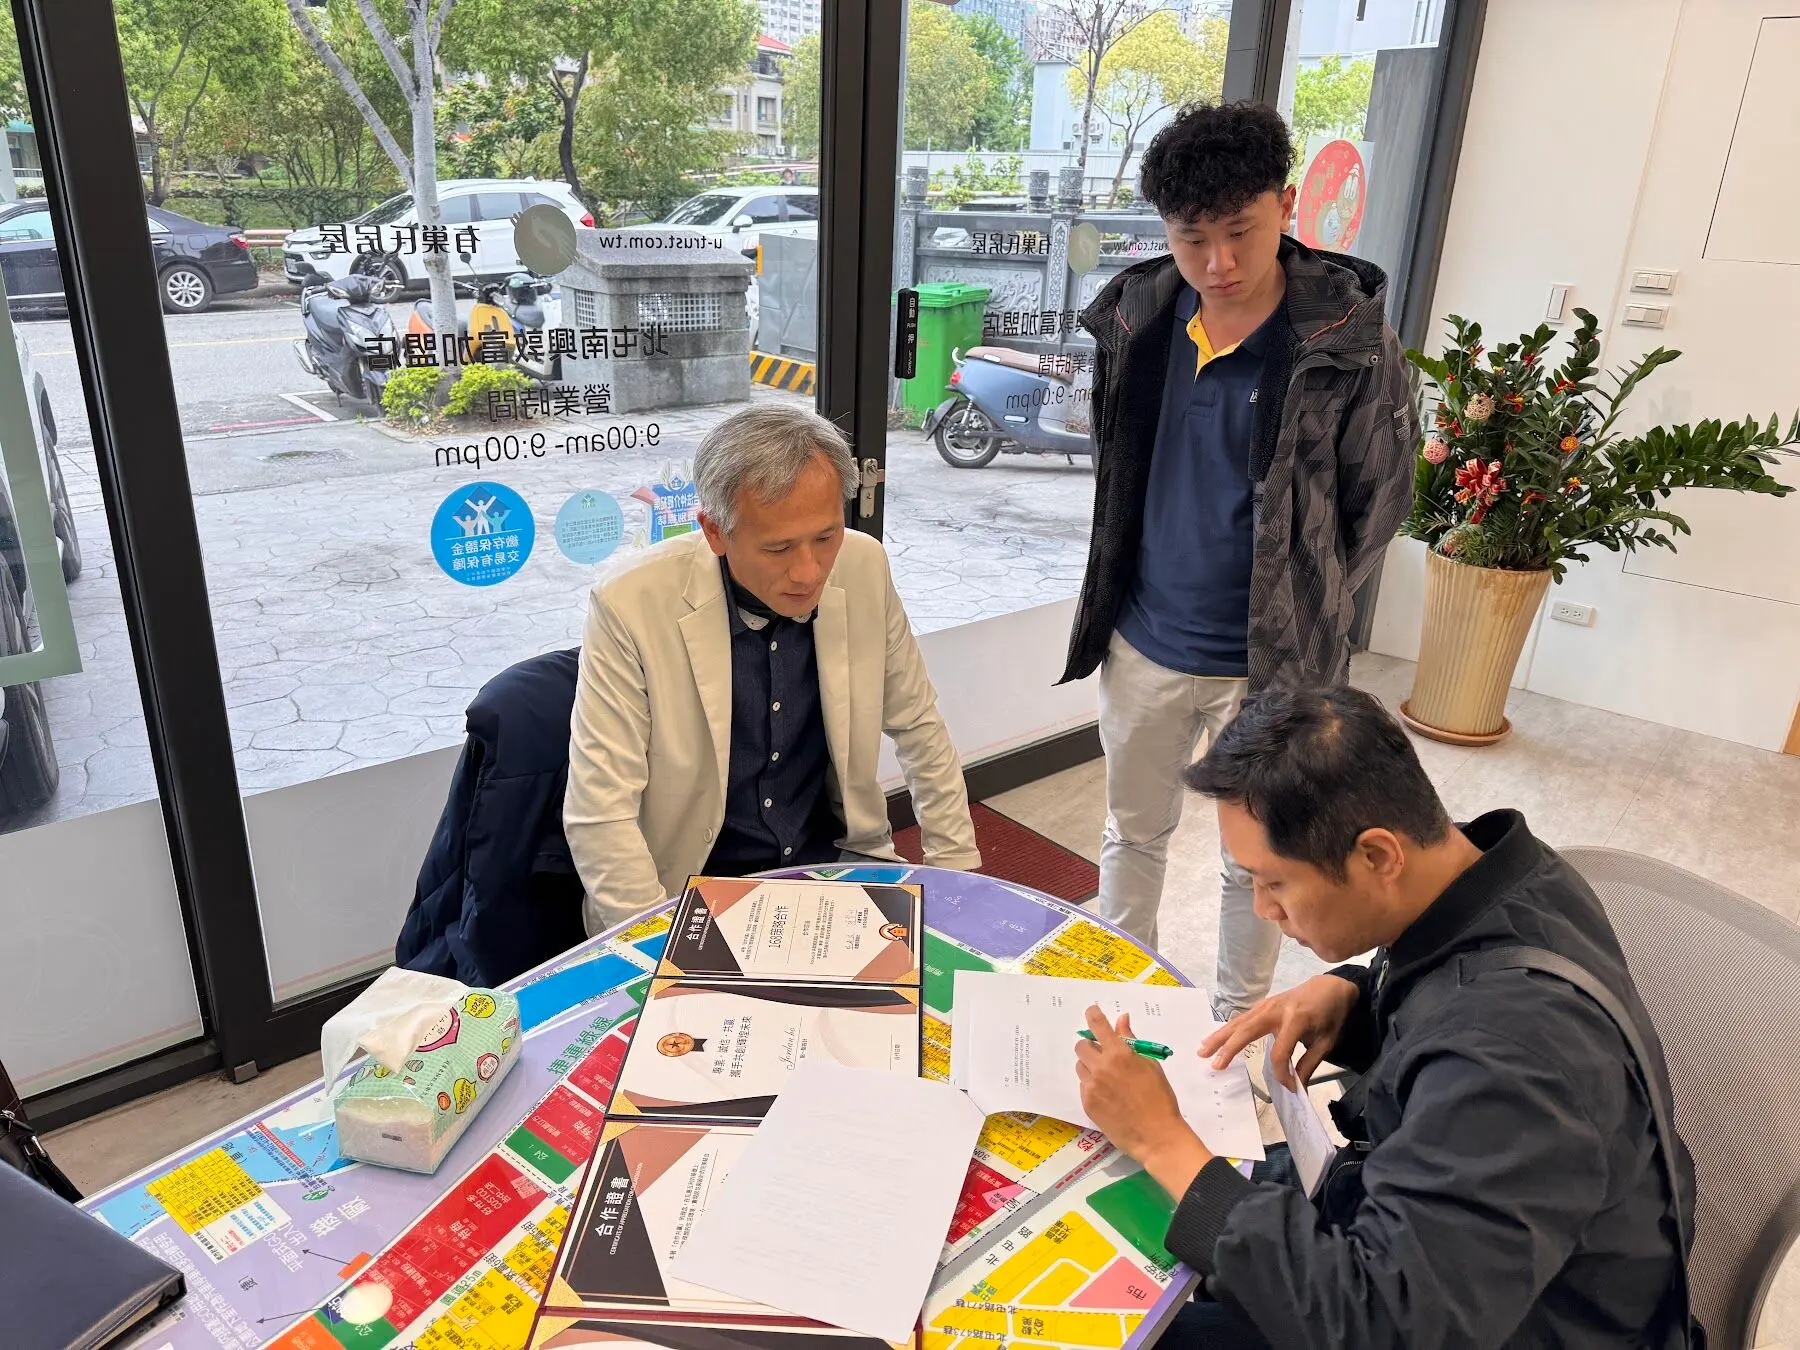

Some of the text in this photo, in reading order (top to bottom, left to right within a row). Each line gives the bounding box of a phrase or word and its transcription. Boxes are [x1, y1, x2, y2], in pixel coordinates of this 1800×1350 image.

[466, 1193, 493, 1217] 好市多
[475, 1187, 503, 1211] COSTCO
[594, 1175, 630, 1237] 合作證書
